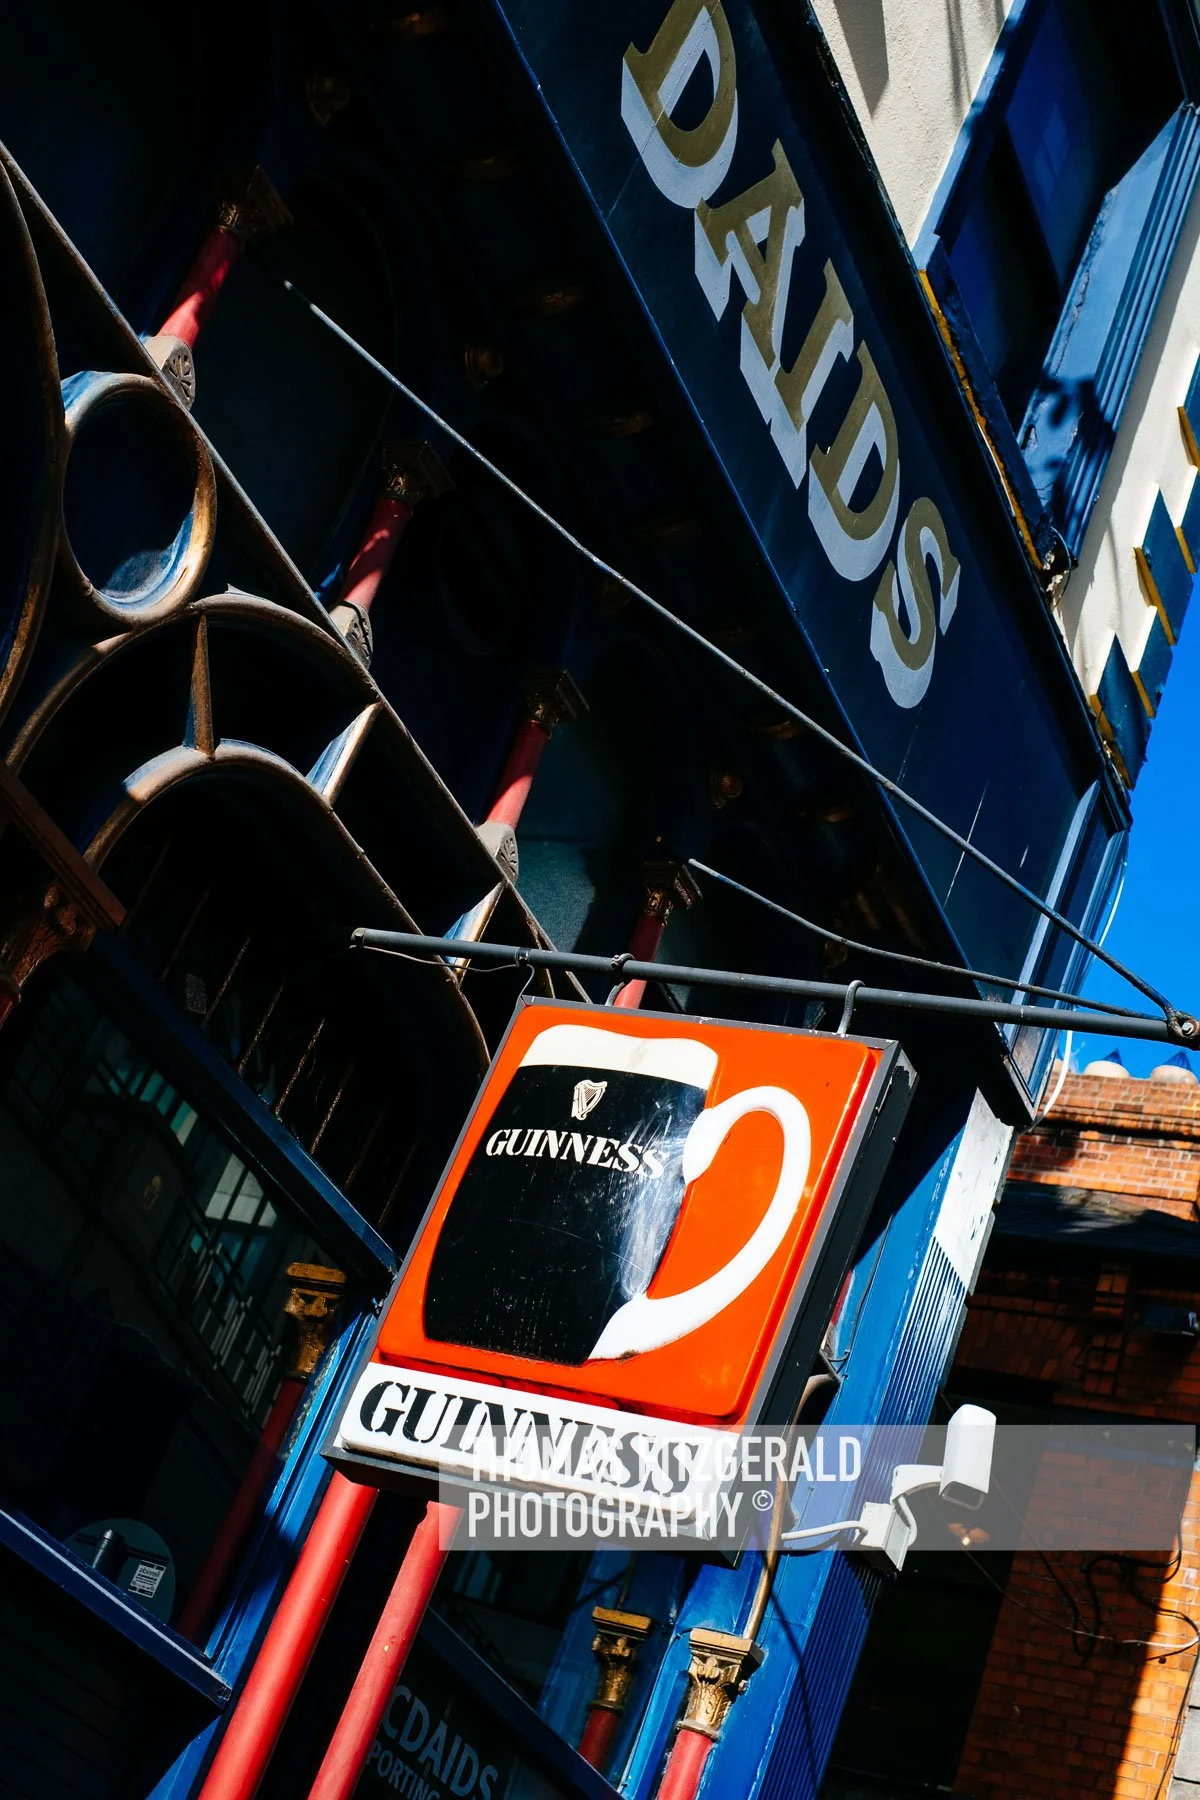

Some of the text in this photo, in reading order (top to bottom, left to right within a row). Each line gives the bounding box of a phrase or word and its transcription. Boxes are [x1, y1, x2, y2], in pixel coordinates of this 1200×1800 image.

[620, 0, 961, 710] DAIDS
[485, 1128, 667, 1180] GUINNESS
[359, 1379, 701, 1498] GUINNESS
